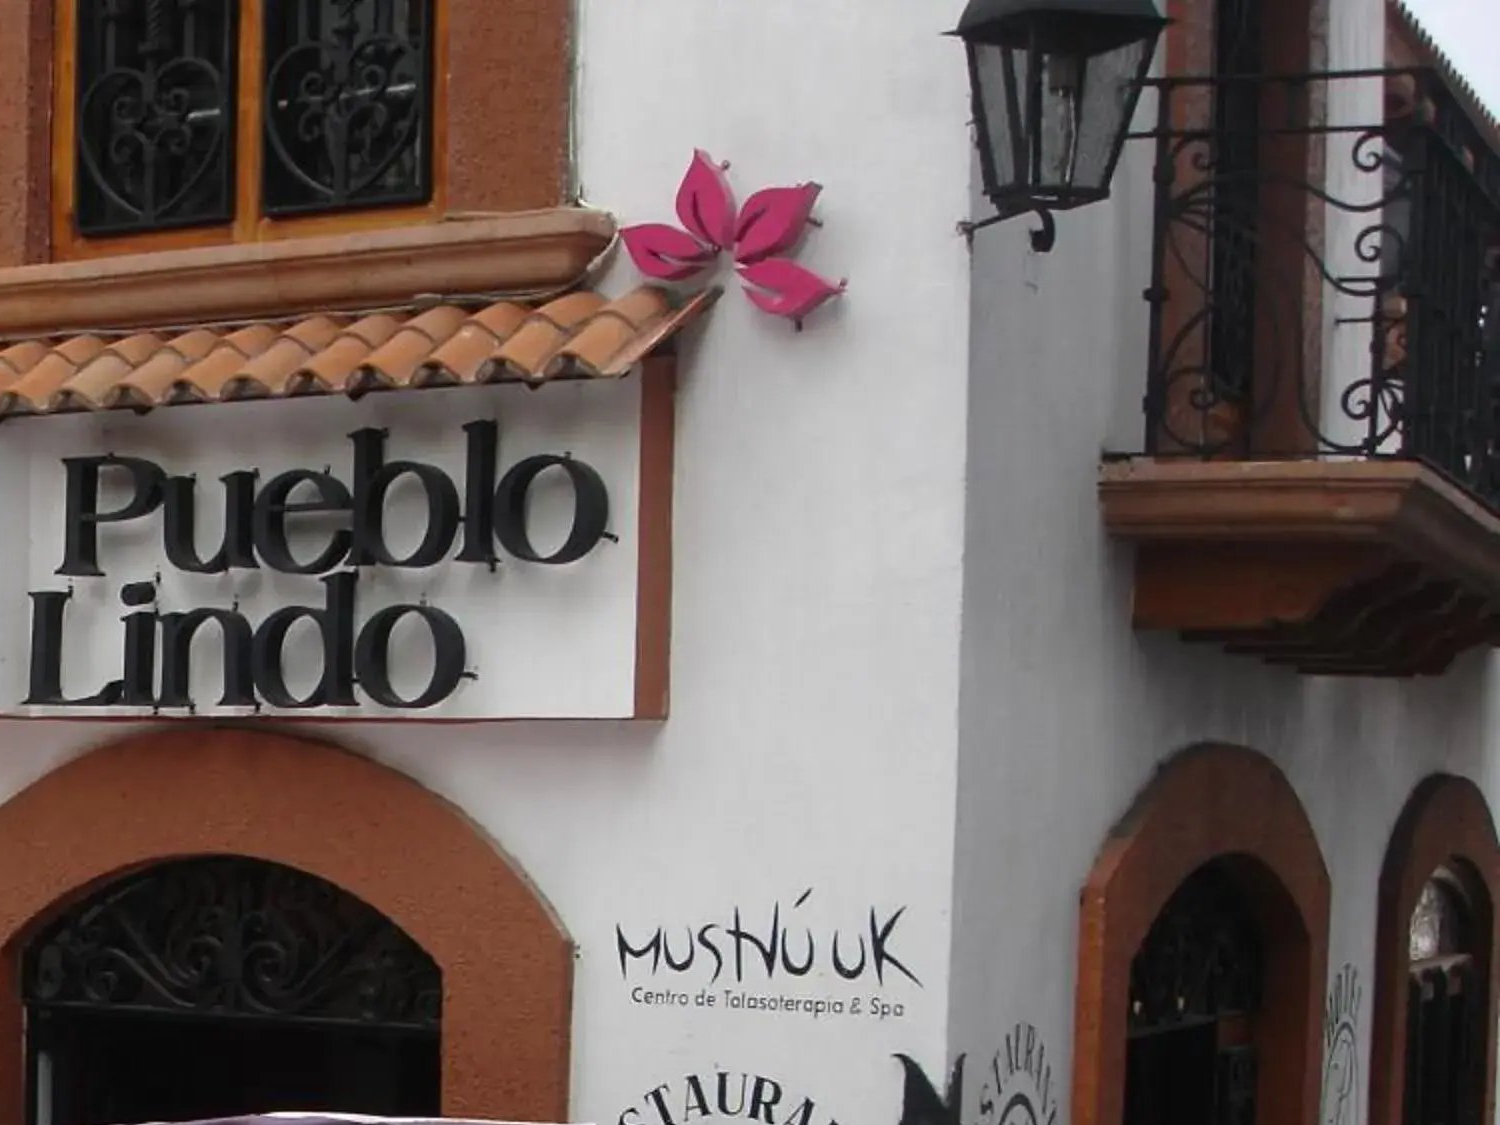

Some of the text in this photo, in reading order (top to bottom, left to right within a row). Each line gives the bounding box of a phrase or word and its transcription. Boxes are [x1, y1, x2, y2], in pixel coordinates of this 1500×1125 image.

[55, 419, 609, 575] Pueblo
[20, 568, 467, 708] Lindo
[631, 986, 905, 1020] Centro de Talasoterapia & Spa
